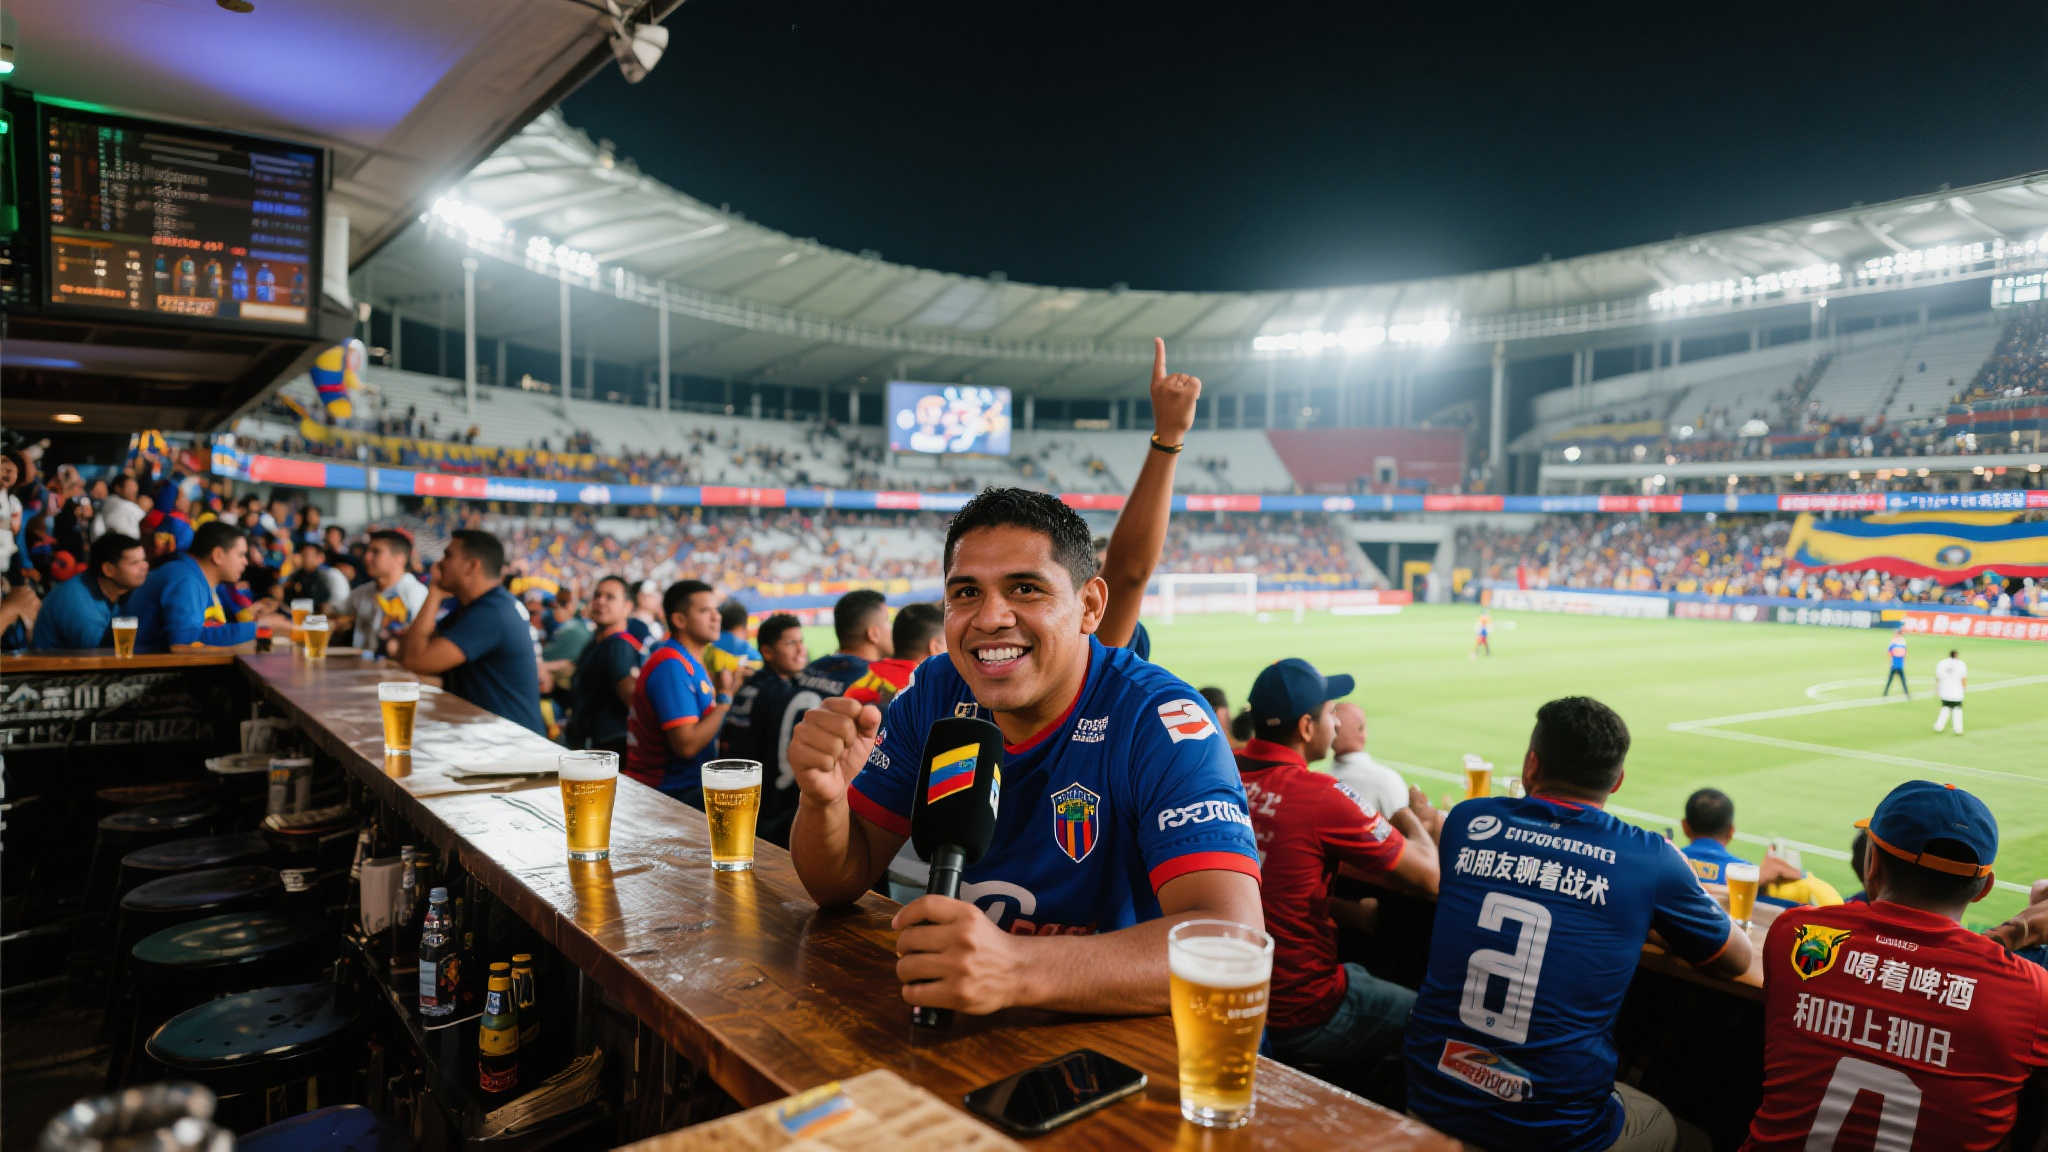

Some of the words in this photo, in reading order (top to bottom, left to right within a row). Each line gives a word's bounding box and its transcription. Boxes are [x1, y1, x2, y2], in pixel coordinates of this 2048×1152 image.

[1455, 846, 1610, 906] 和朋友聊着战术
[1844, 950, 1978, 1011] 喝着啤酒
